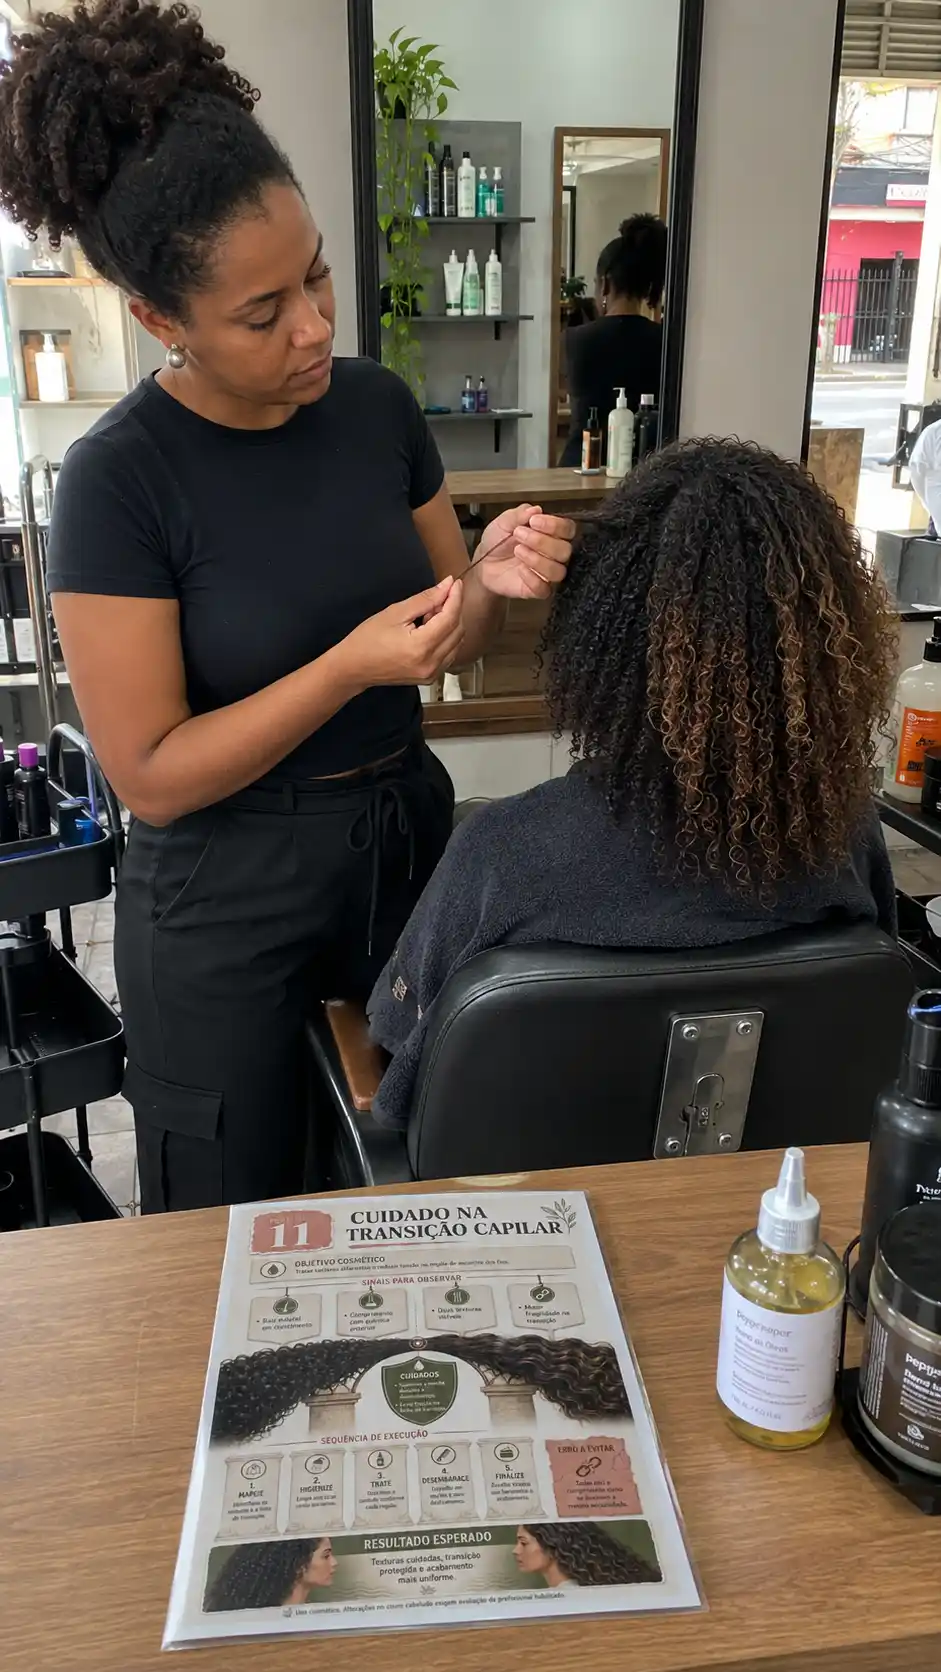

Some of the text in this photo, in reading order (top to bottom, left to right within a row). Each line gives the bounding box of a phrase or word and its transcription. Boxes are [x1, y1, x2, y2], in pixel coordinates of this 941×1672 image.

[351, 1206, 488, 1225] CUIDADO NA
[270, 1221, 310, 1248] 11
[346, 1221, 564, 1242] TRANSIÇÃO CAPILAR
[295, 1256, 385, 1267] OBJETIVO COSMÉTICO
[362, 1275, 462, 1286] SINAIS PARA OBSERVAR
[400, 1371, 440, 1380] CUIDADOS
[321, 1429, 428, 1445] SEQUÊNCIA DE EXECUÇÃO
[587, 1444, 615, 1453] EVITAR
[505, 1464, 513, 1472] 5.
[495, 1472, 525, 1480] FINALIZE
[300, 1484, 333, 1493] HIGIENIZE
[371, 1480, 392, 1488] TRATE
[364, 1531, 492, 1550] RESULTADO ESPERADO
[371, 1551, 481, 1566] Texturas cuidadas, transição
[380, 1565, 417, 1577] protegida
[426, 1563, 473, 1572] acabamento
[398, 1574, 457, 1584] mais uniforme.
